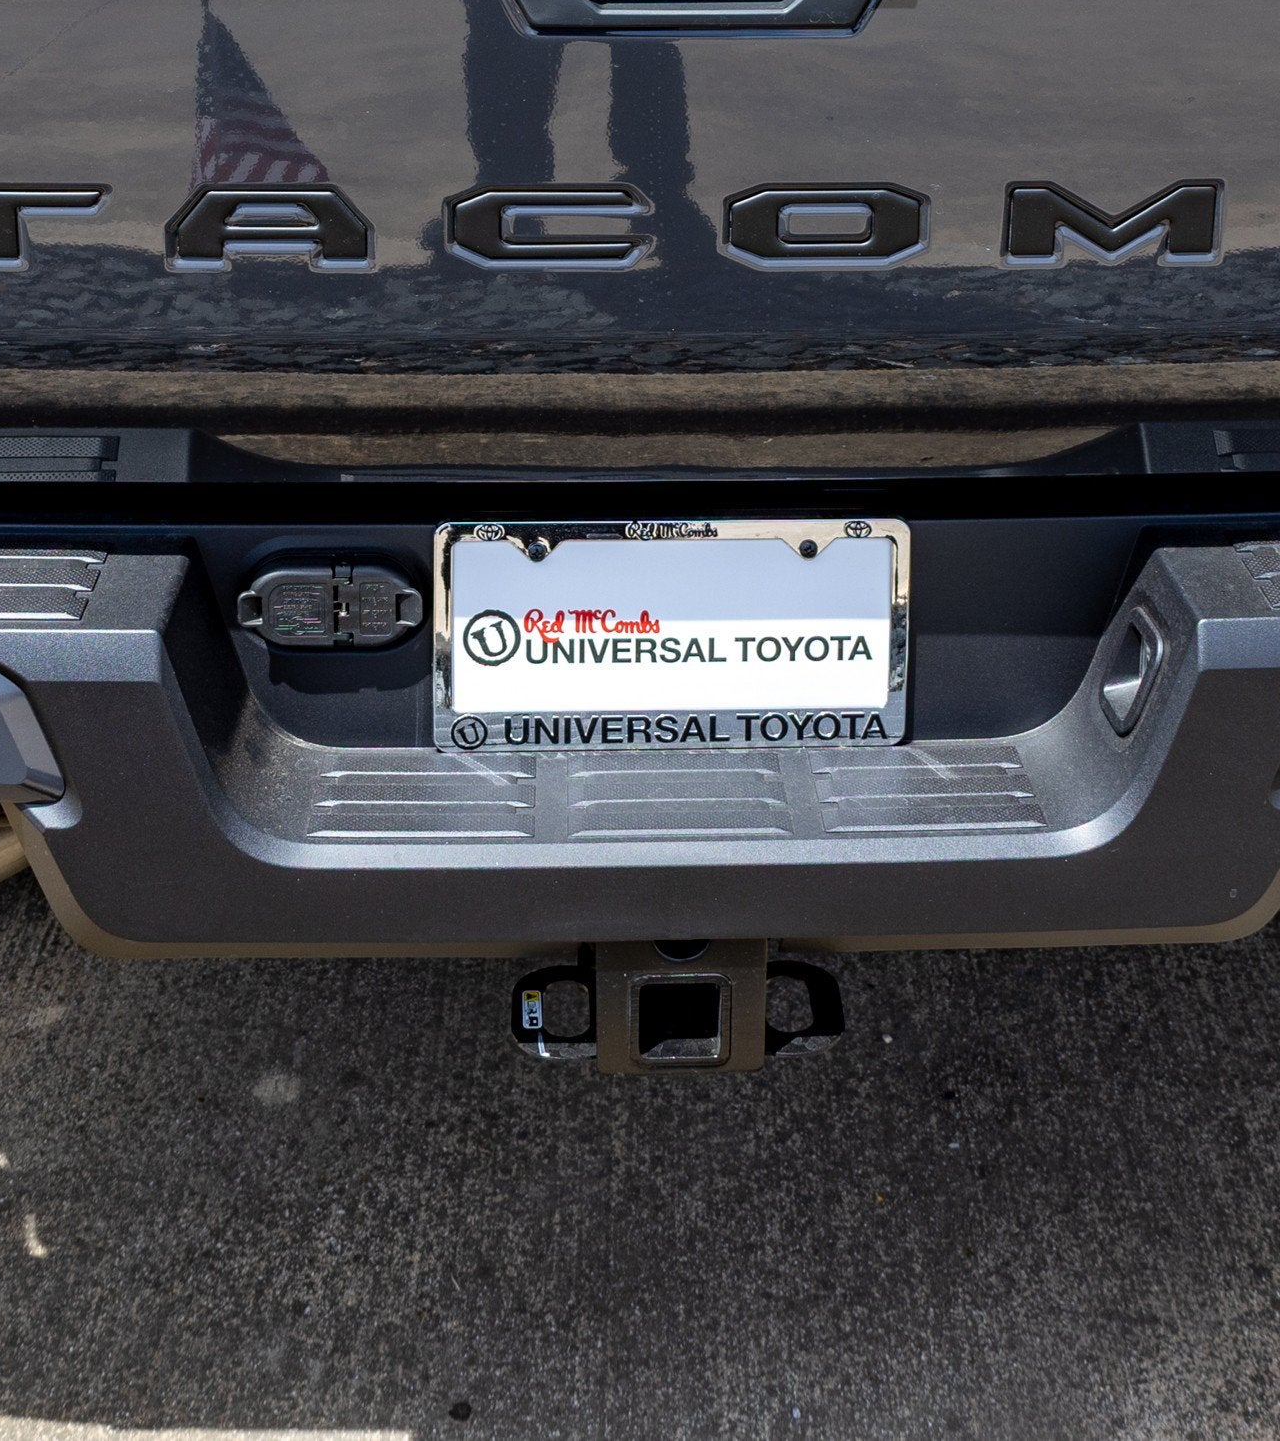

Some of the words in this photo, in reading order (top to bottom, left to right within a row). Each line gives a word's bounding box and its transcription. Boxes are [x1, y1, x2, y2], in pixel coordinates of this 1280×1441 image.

[625, 520, 657, 541] Red
[523, 608, 565, 644] Red
[567, 608, 661, 635] McCombs
[525, 637, 727, 665] UNIVERSAL
[735, 635, 873, 662] TOYOTA
[503, 714, 730, 746] UNIVERSAL
[736, 711, 890, 742] TOYOTA
